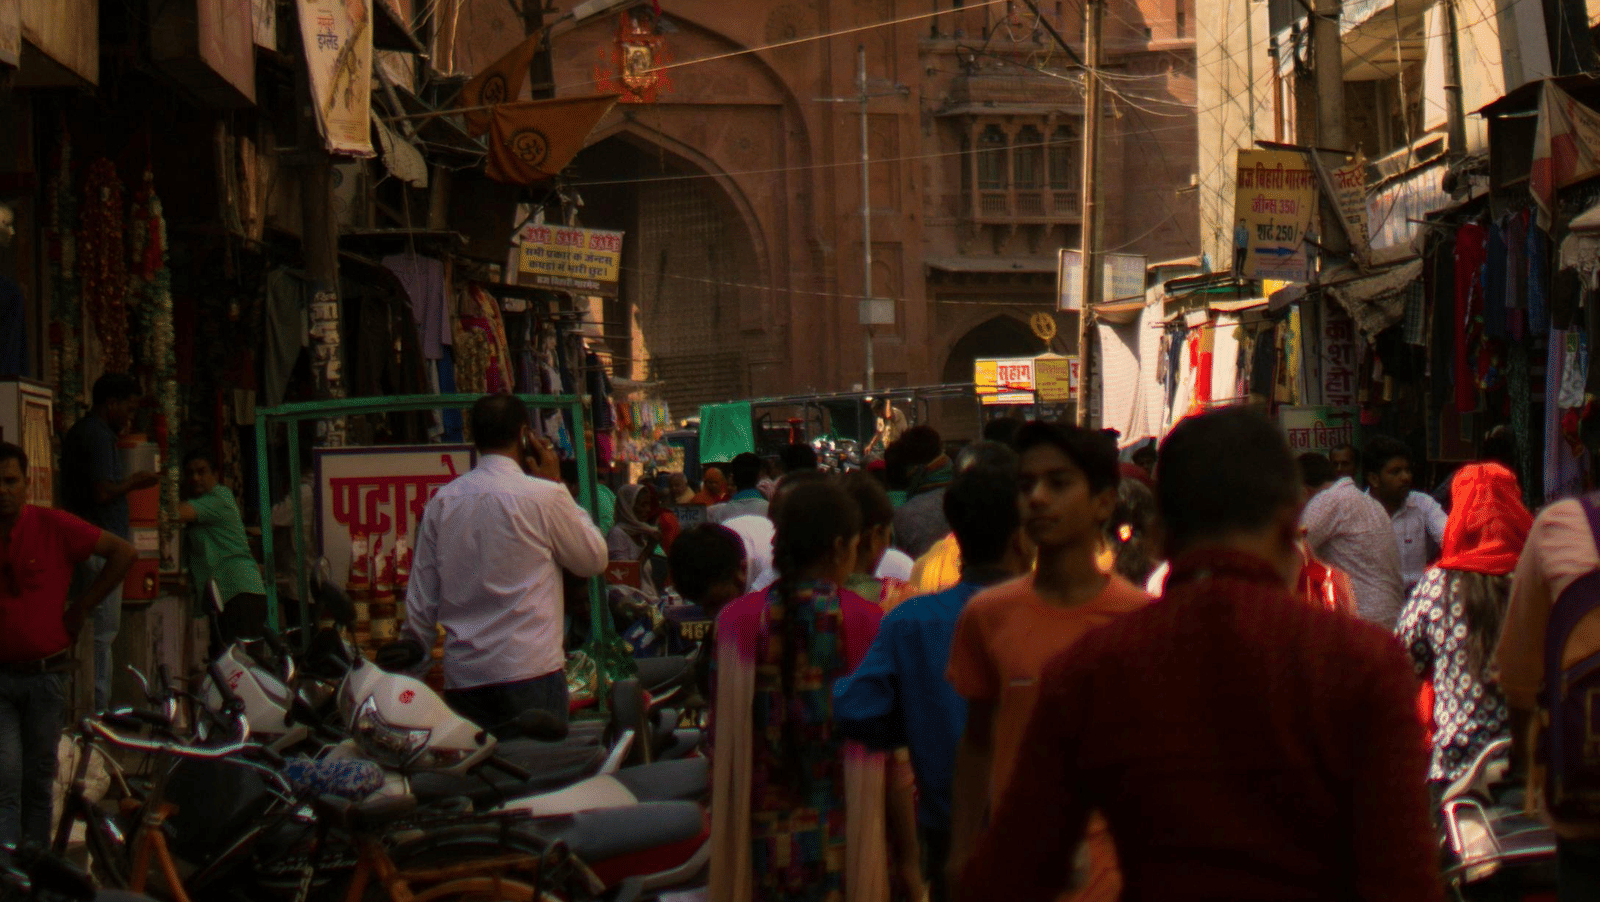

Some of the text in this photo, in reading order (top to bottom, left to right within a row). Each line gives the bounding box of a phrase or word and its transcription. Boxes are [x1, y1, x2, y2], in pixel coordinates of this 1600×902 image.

[1256, 162, 1283, 189] बिहारी
[527, 227, 620, 252] ALE SALE SALE
[1313, 421, 1353, 449] बिहारी
